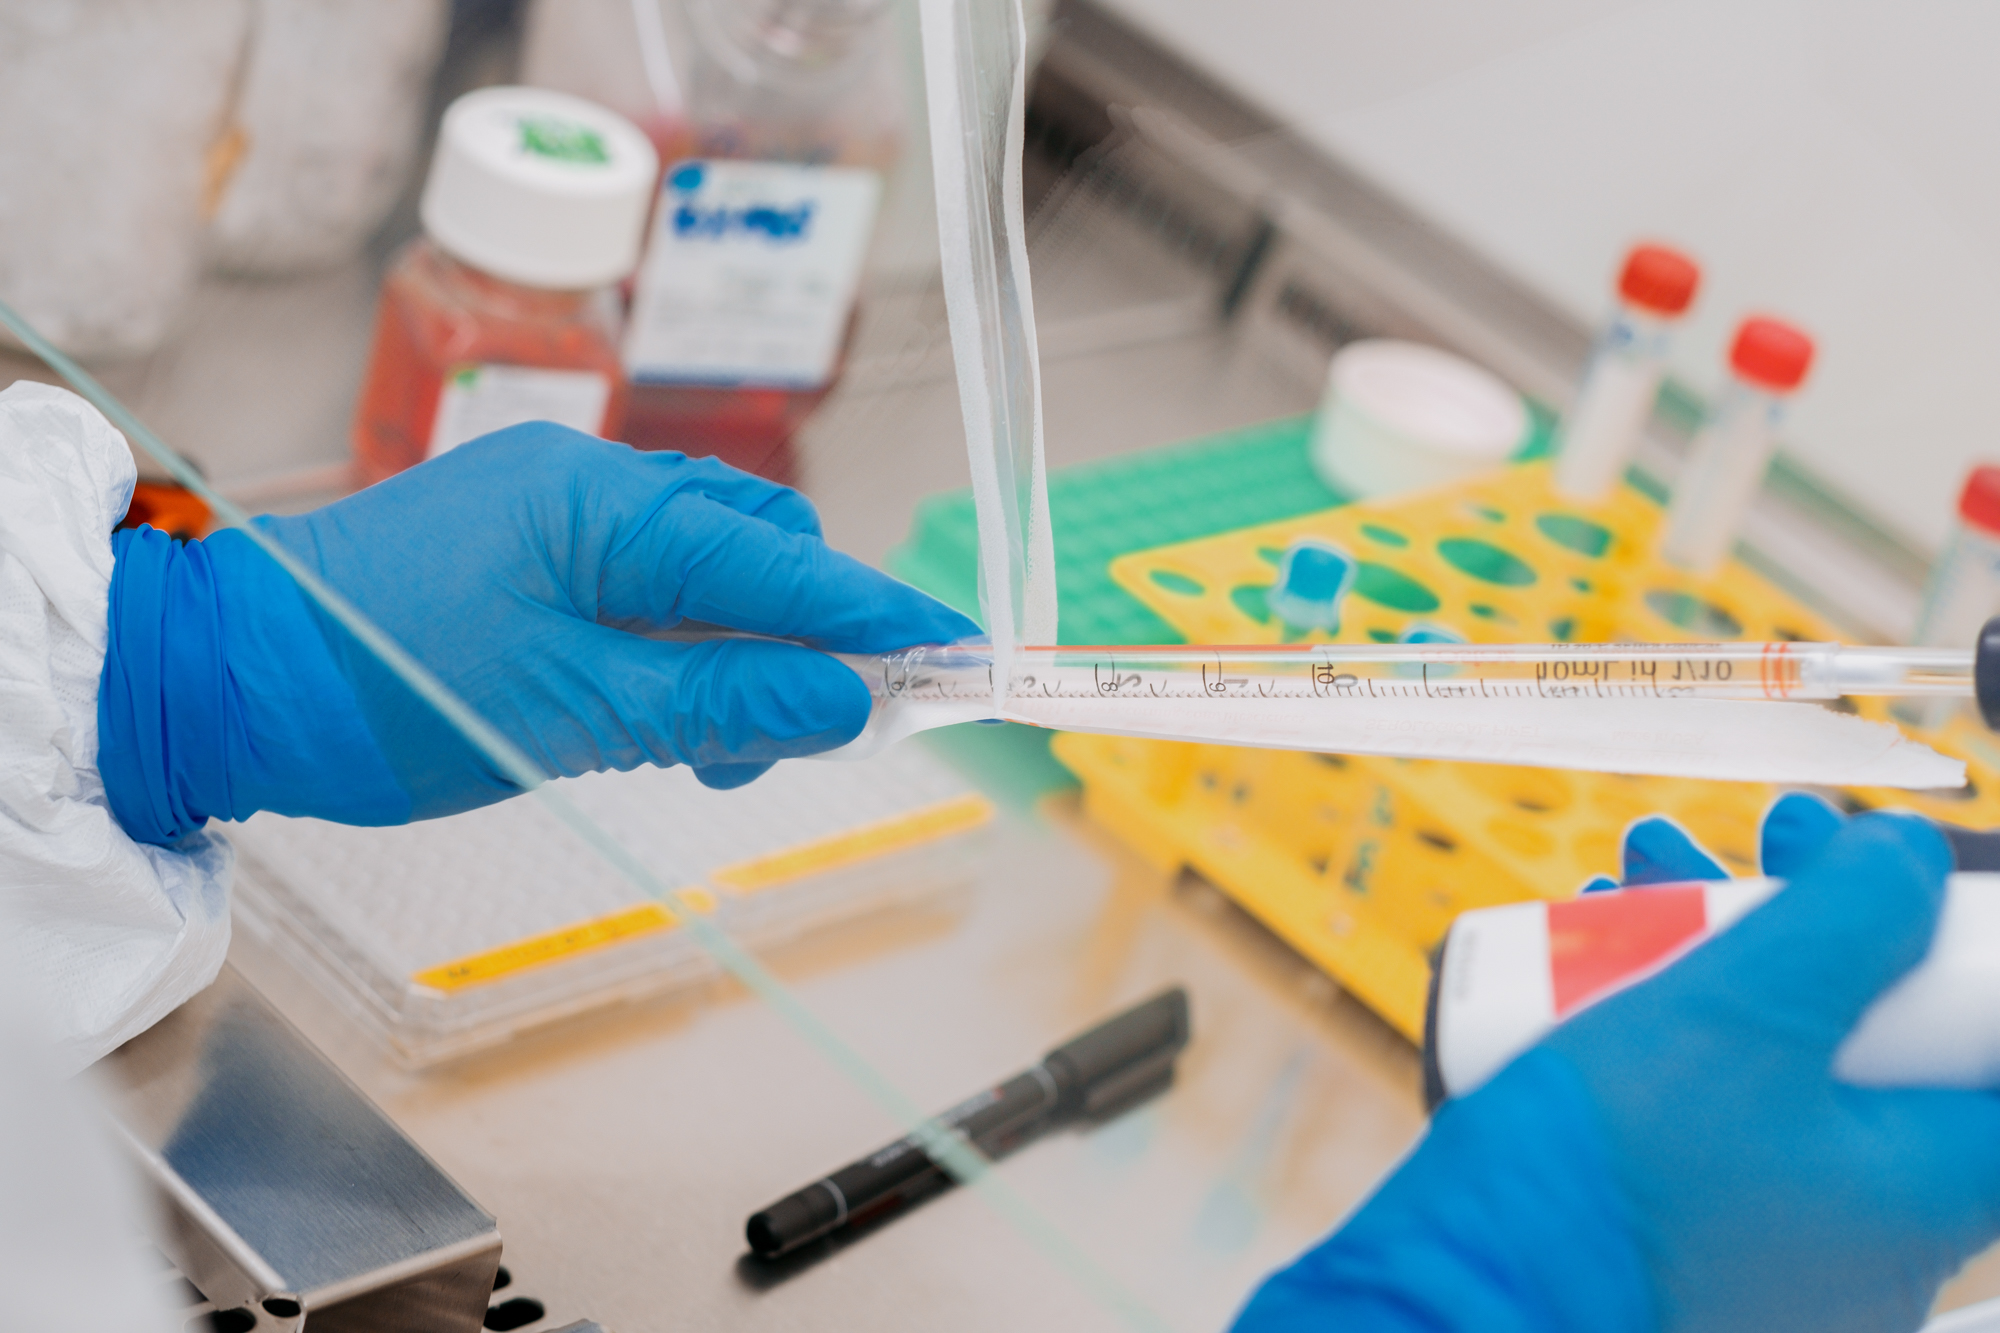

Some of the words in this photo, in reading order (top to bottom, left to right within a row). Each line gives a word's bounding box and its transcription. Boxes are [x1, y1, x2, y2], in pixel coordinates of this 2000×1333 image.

[1317, 664, 1335, 685] 10
[1101, 682, 1119, 692] 8
[1209, 682, 1227, 692] 9
